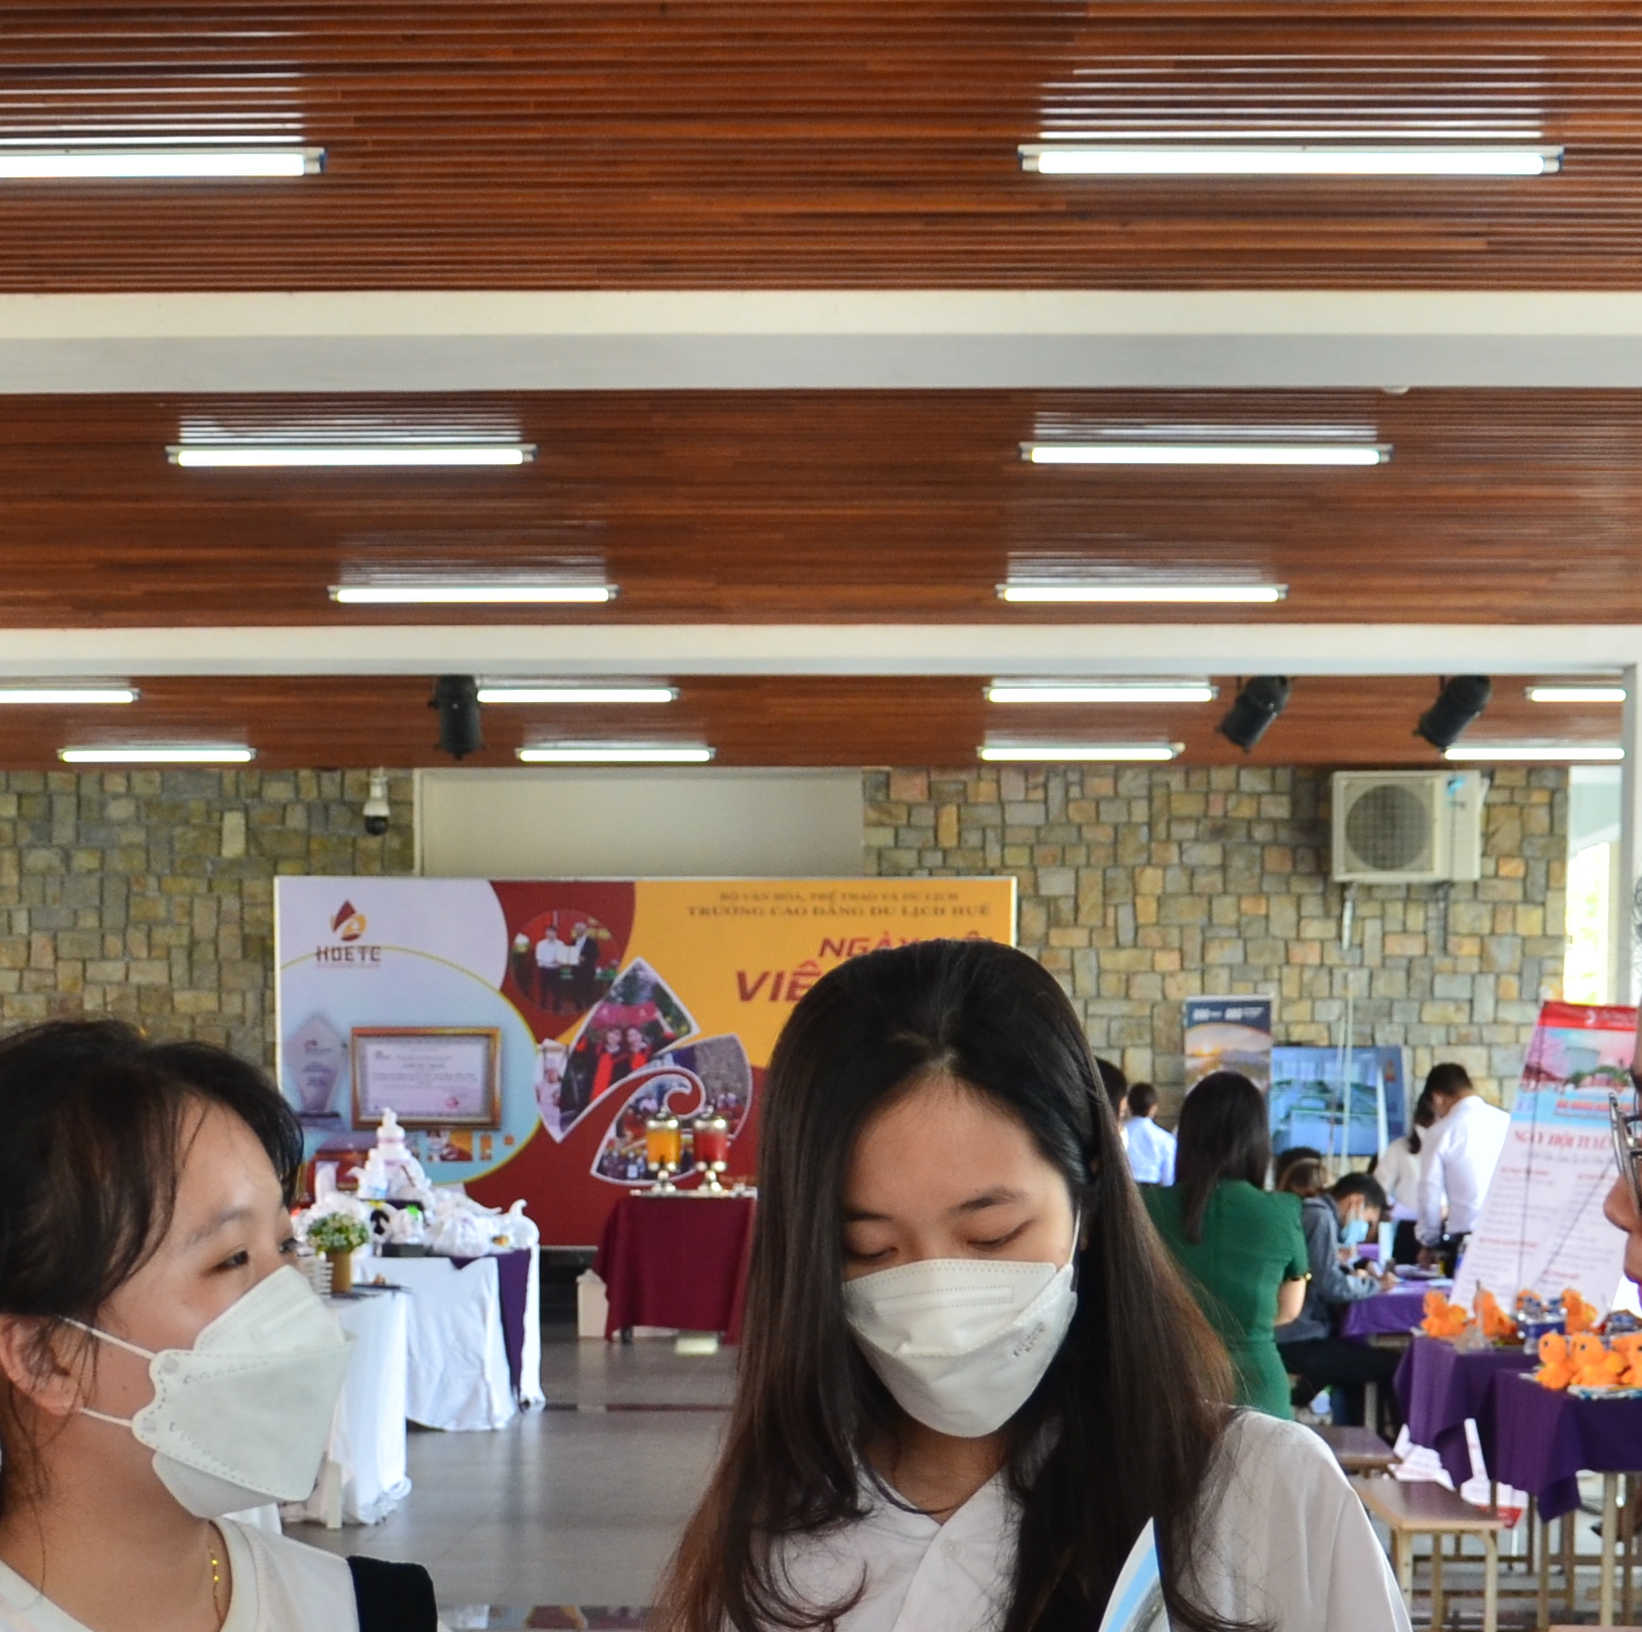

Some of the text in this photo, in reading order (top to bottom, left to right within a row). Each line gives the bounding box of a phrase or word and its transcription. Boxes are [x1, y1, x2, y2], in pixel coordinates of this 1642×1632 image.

[768, 905, 807, 917] CAO
[870, 905, 895, 917] DU
[819, 930, 918, 958] NGÀ
